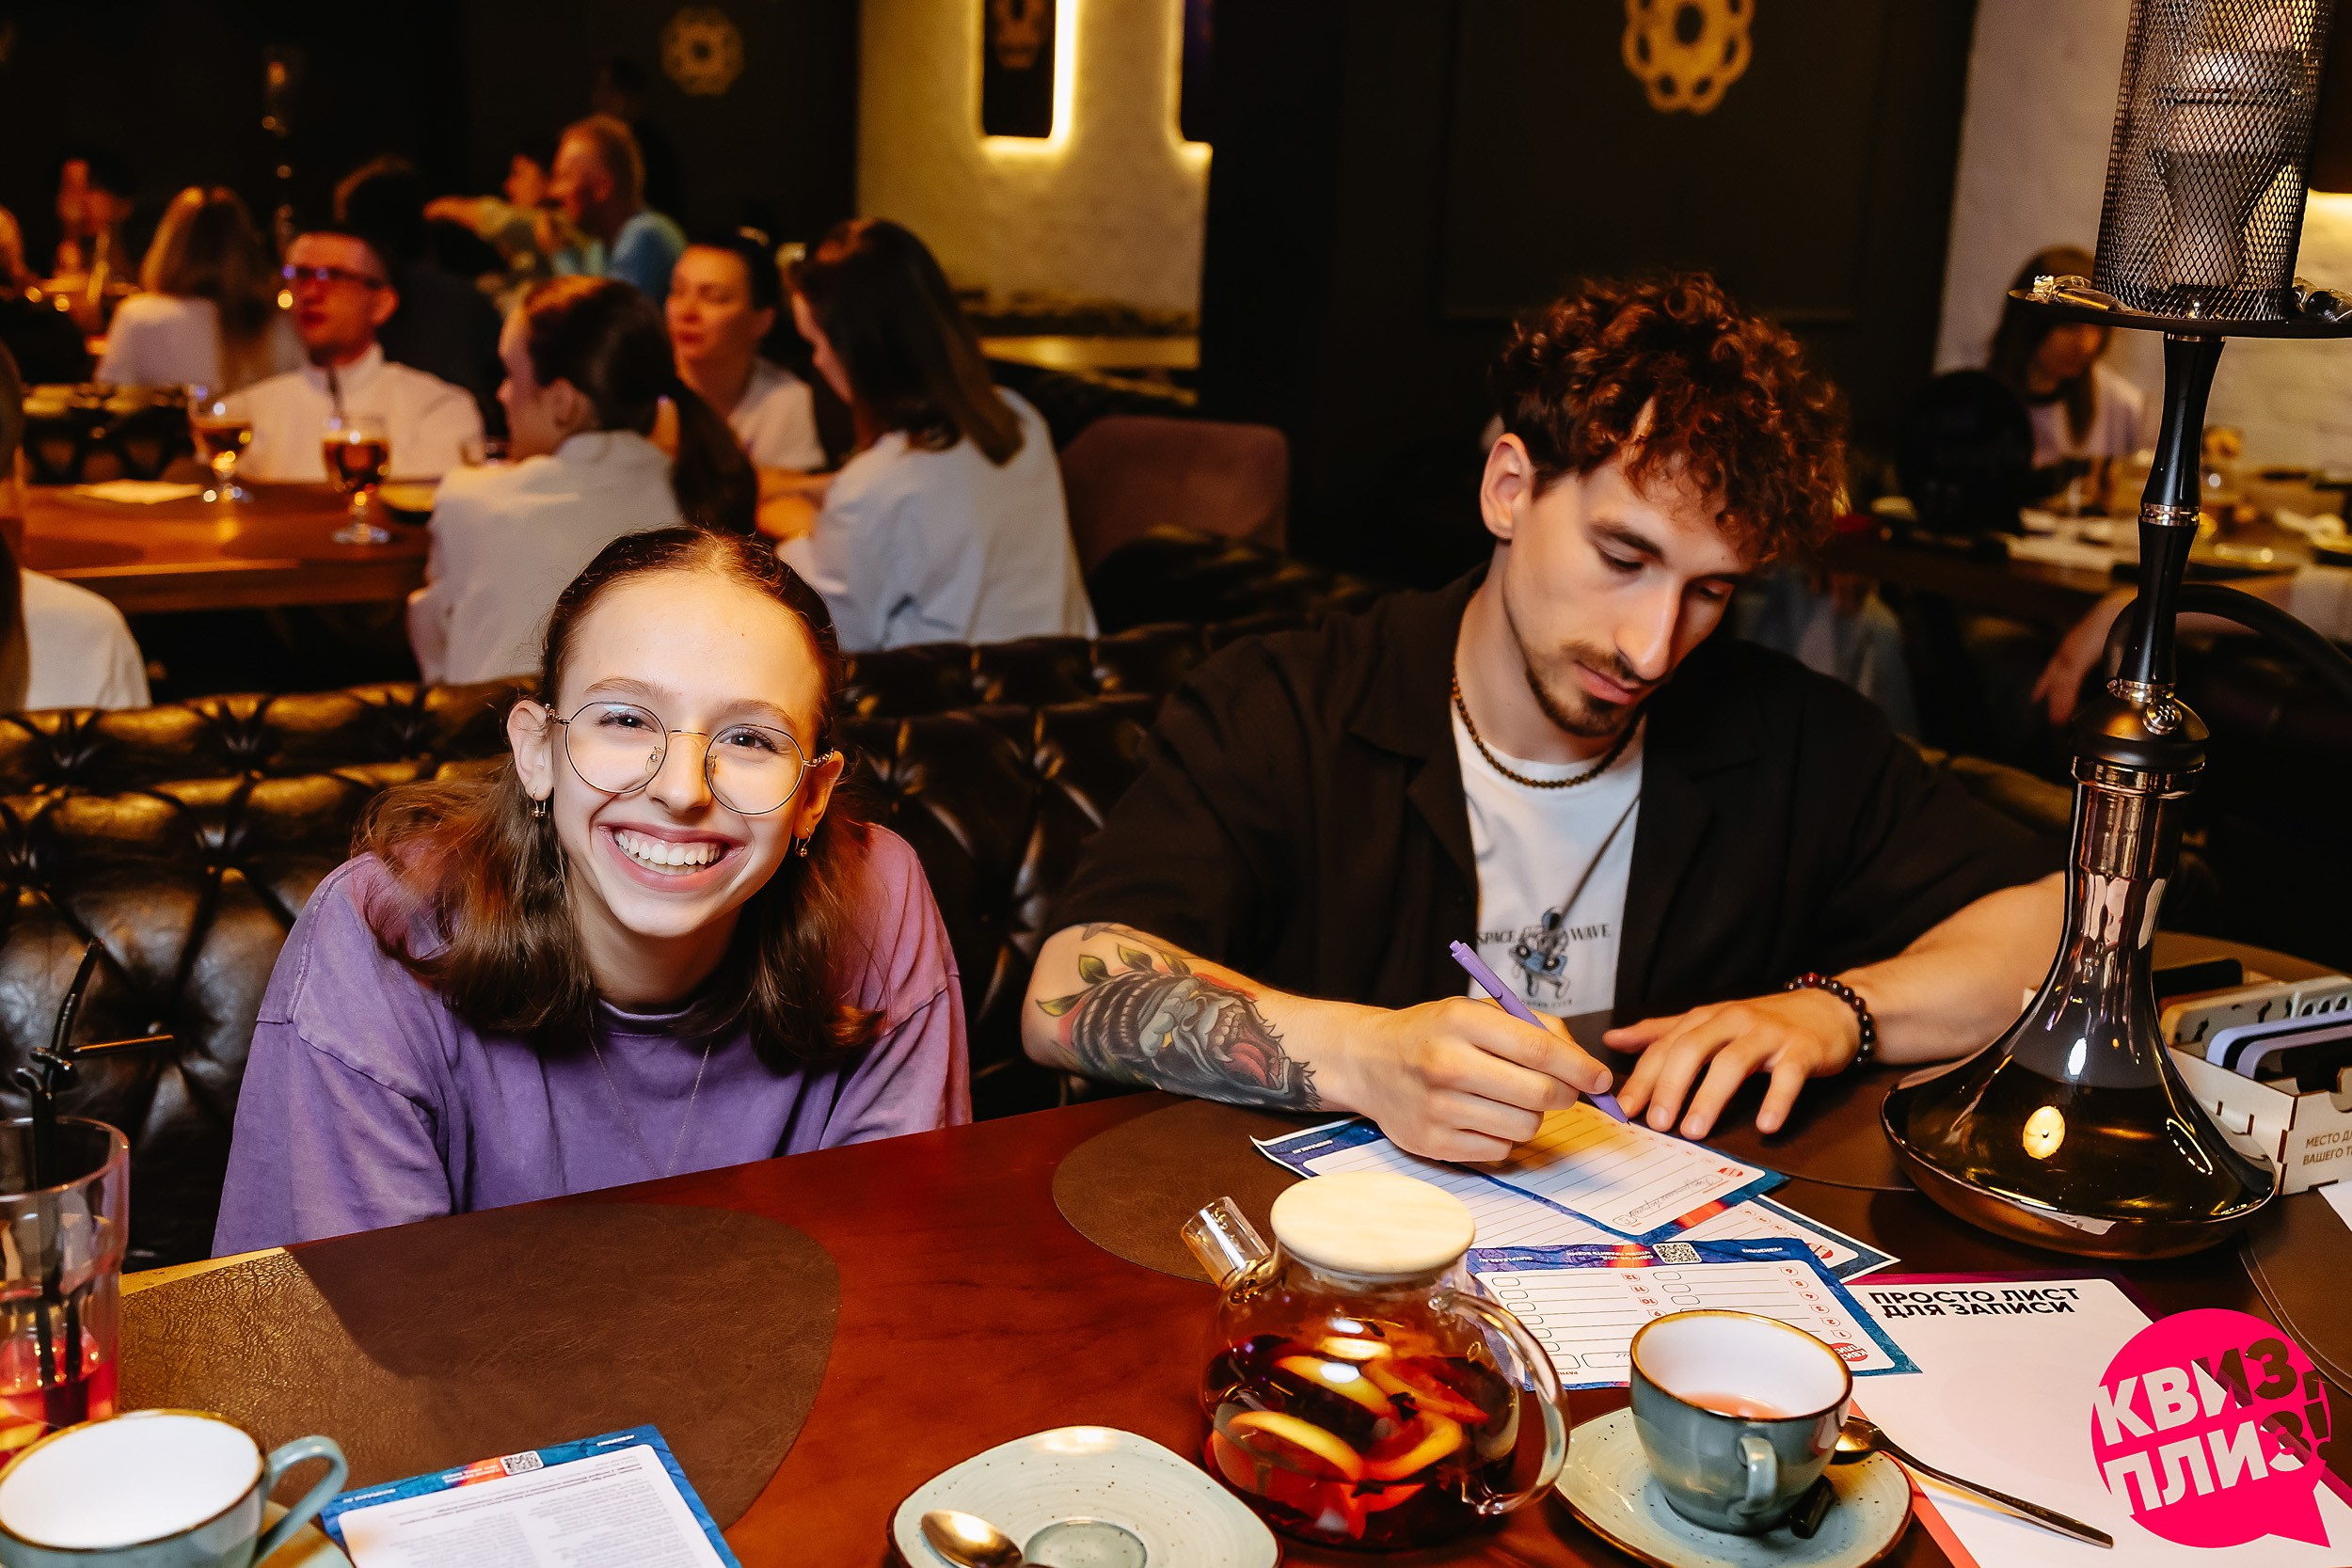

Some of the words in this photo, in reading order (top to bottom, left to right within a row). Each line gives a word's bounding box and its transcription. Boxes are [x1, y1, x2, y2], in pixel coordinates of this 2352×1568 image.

[1571, 924, 1612, 941] WAVE
[2305, 1132, 2340, 1148] МЕСТО
[2342, 1130, 2352, 1142] Д
[2302, 1148, 2344, 1165] ВАШЕГО
[1867, 1290, 1995, 1305] ПРОСТО
[2000, 1288, 2080, 1302] ЛИСТ
[1882, 1304, 1947, 1319] ДЛЯ
[1948, 1302, 2075, 1316] ЗАПИСИ
